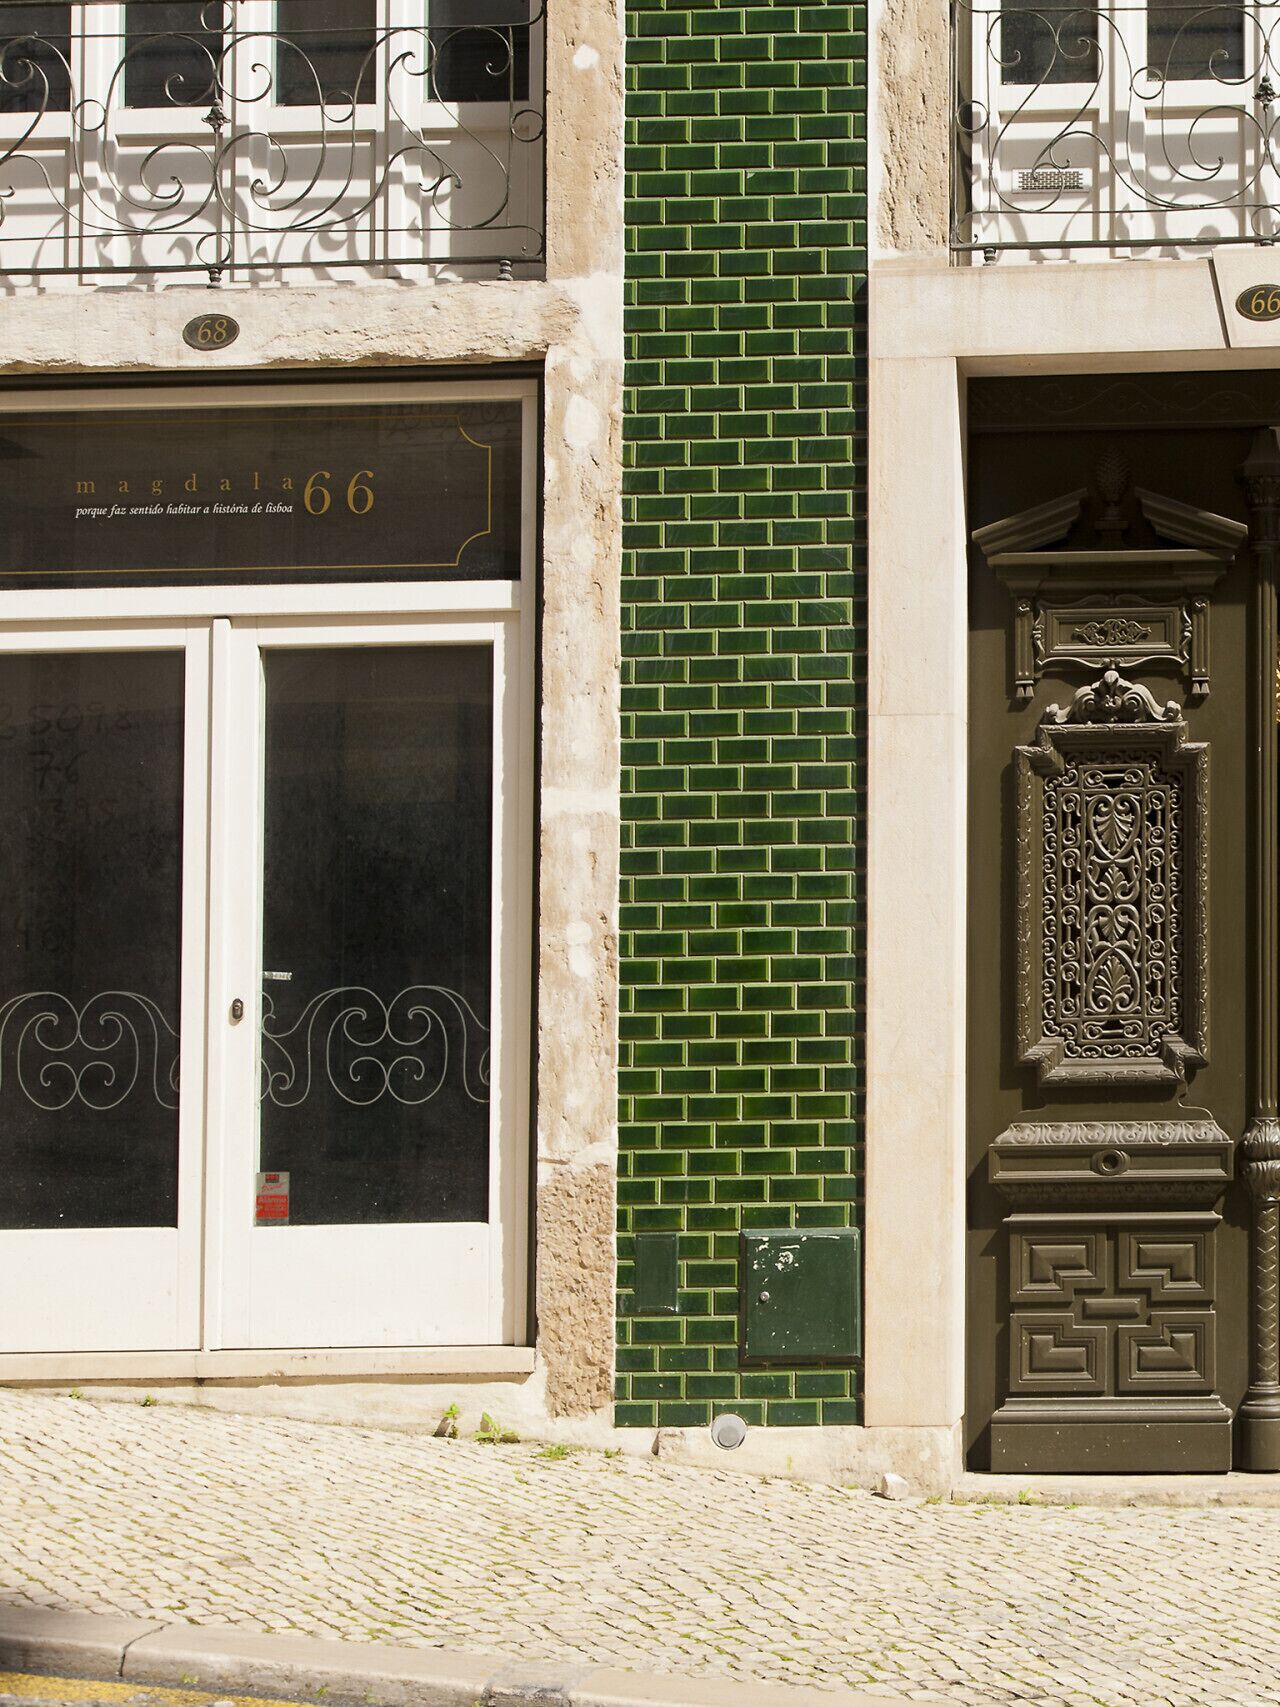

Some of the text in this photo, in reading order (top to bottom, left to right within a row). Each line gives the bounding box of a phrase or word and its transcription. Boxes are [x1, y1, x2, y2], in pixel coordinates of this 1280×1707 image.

[1250, 289, 1280, 314] 66
[197, 319, 227, 343] 68
[75, 502, 293, 519] porque faz sentido habitar a história de lisboa
